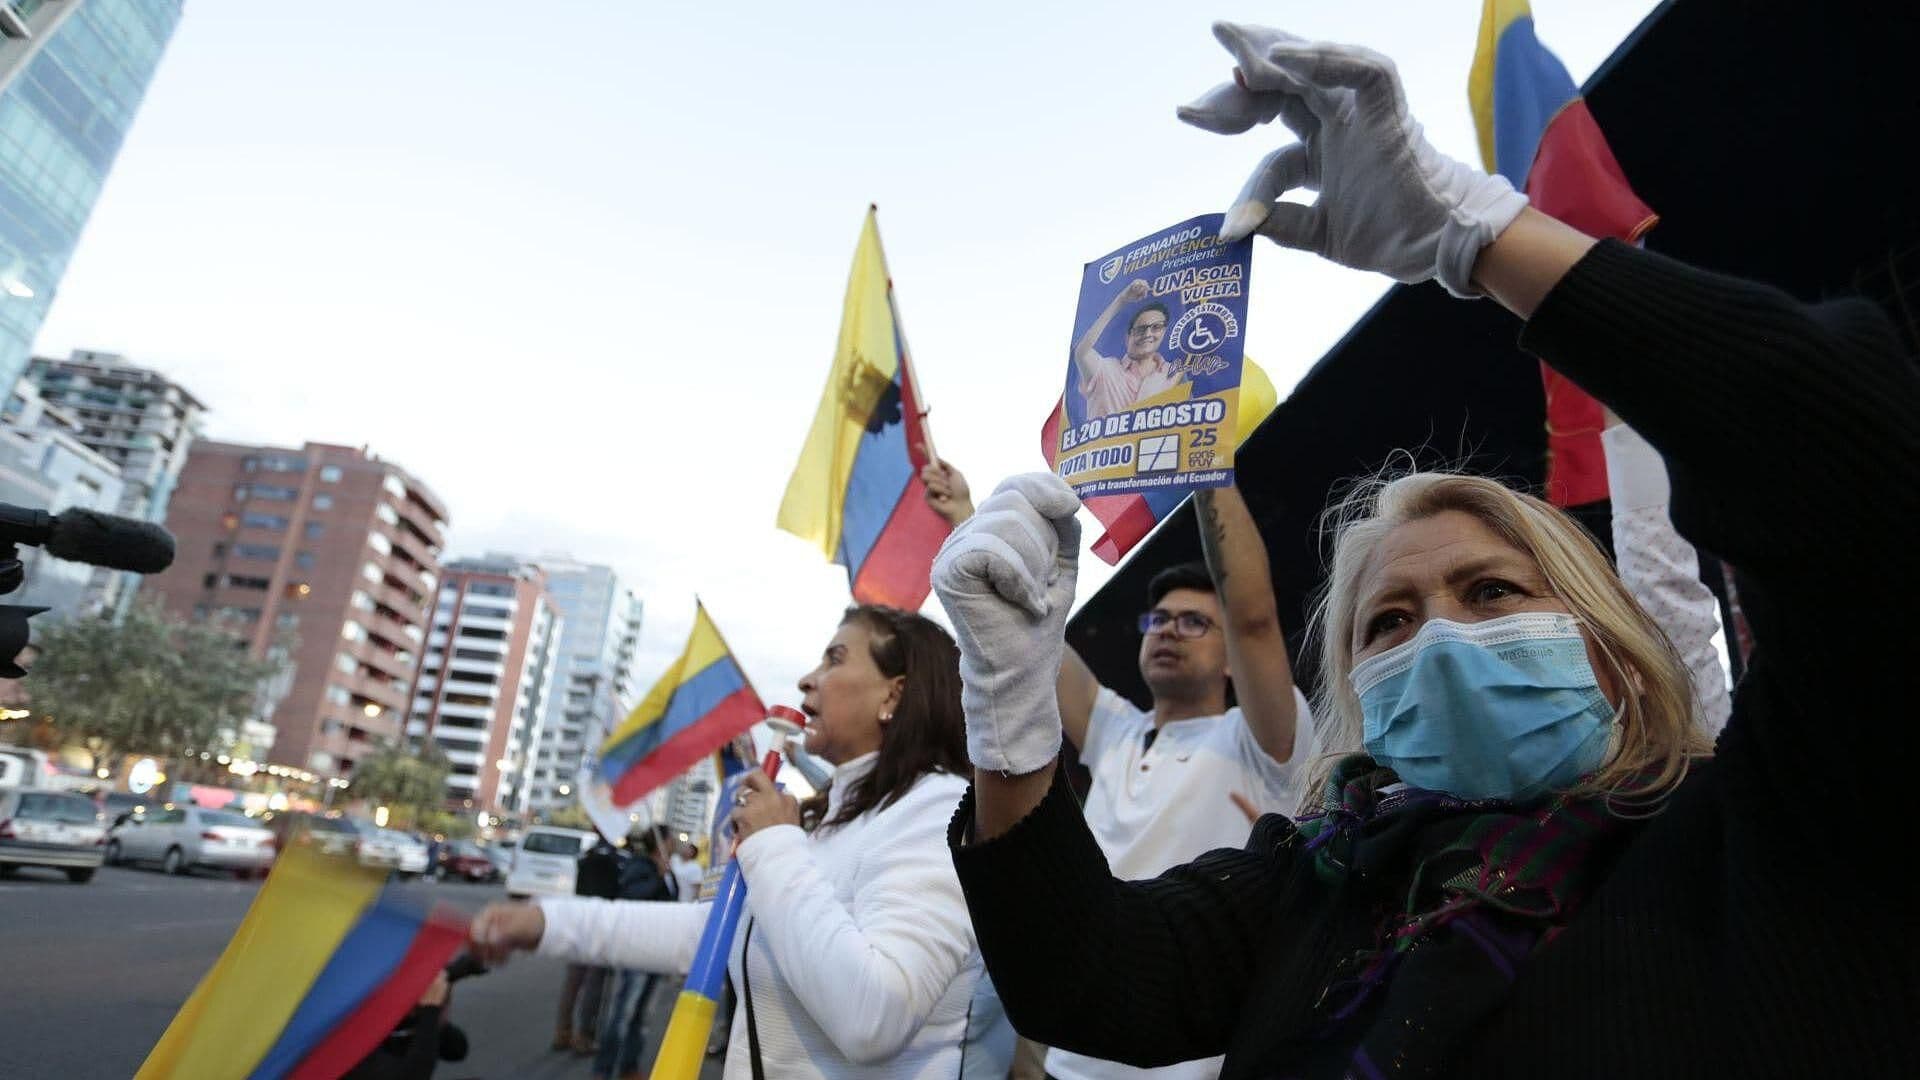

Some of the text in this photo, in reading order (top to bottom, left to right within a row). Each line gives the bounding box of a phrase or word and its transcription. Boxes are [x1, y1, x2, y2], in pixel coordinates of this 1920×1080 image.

[1122, 234, 1227, 275] VILLAVICENCIO
[1125, 225, 1202, 264] FERNANDO
[1152, 264, 1242, 296] UNA SOLA
[1181, 281, 1241, 304] VUELTA
[1061, 399, 1224, 451] EL 20 DE AGOSTO
[1190, 427, 1217, 448] 25
[1058, 443, 1134, 478] VOTA TODO
[1098, 479, 1106, 490] la
[1174, 474, 1187, 486] del
[1189, 471, 1227, 483] Ecuador
